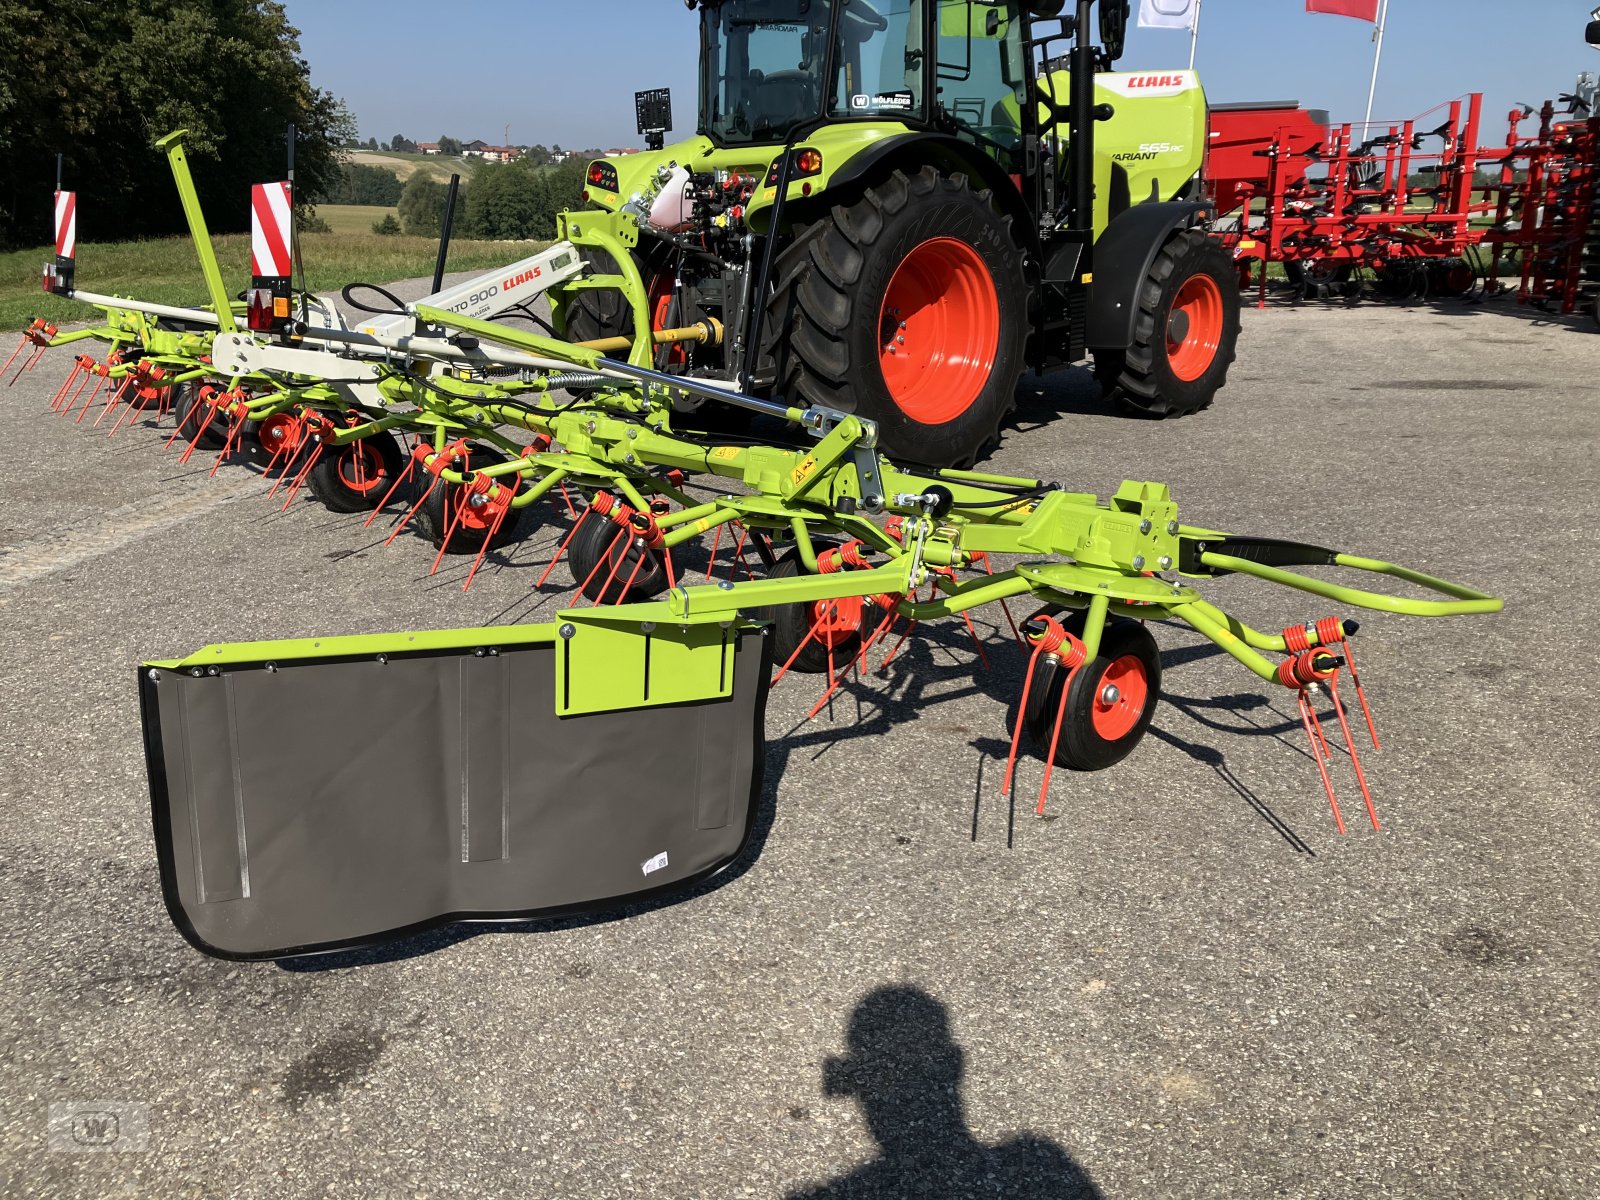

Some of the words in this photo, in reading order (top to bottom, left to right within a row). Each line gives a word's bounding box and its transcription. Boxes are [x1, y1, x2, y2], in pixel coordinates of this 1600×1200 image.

[1128, 75, 1182, 87] CLAAS
[871, 96, 910, 105] WÖLFLEDER
[1139, 143, 1171, 152] 565
[470, 285, 498, 306] 900
[503, 266, 541, 291] CLAAS
